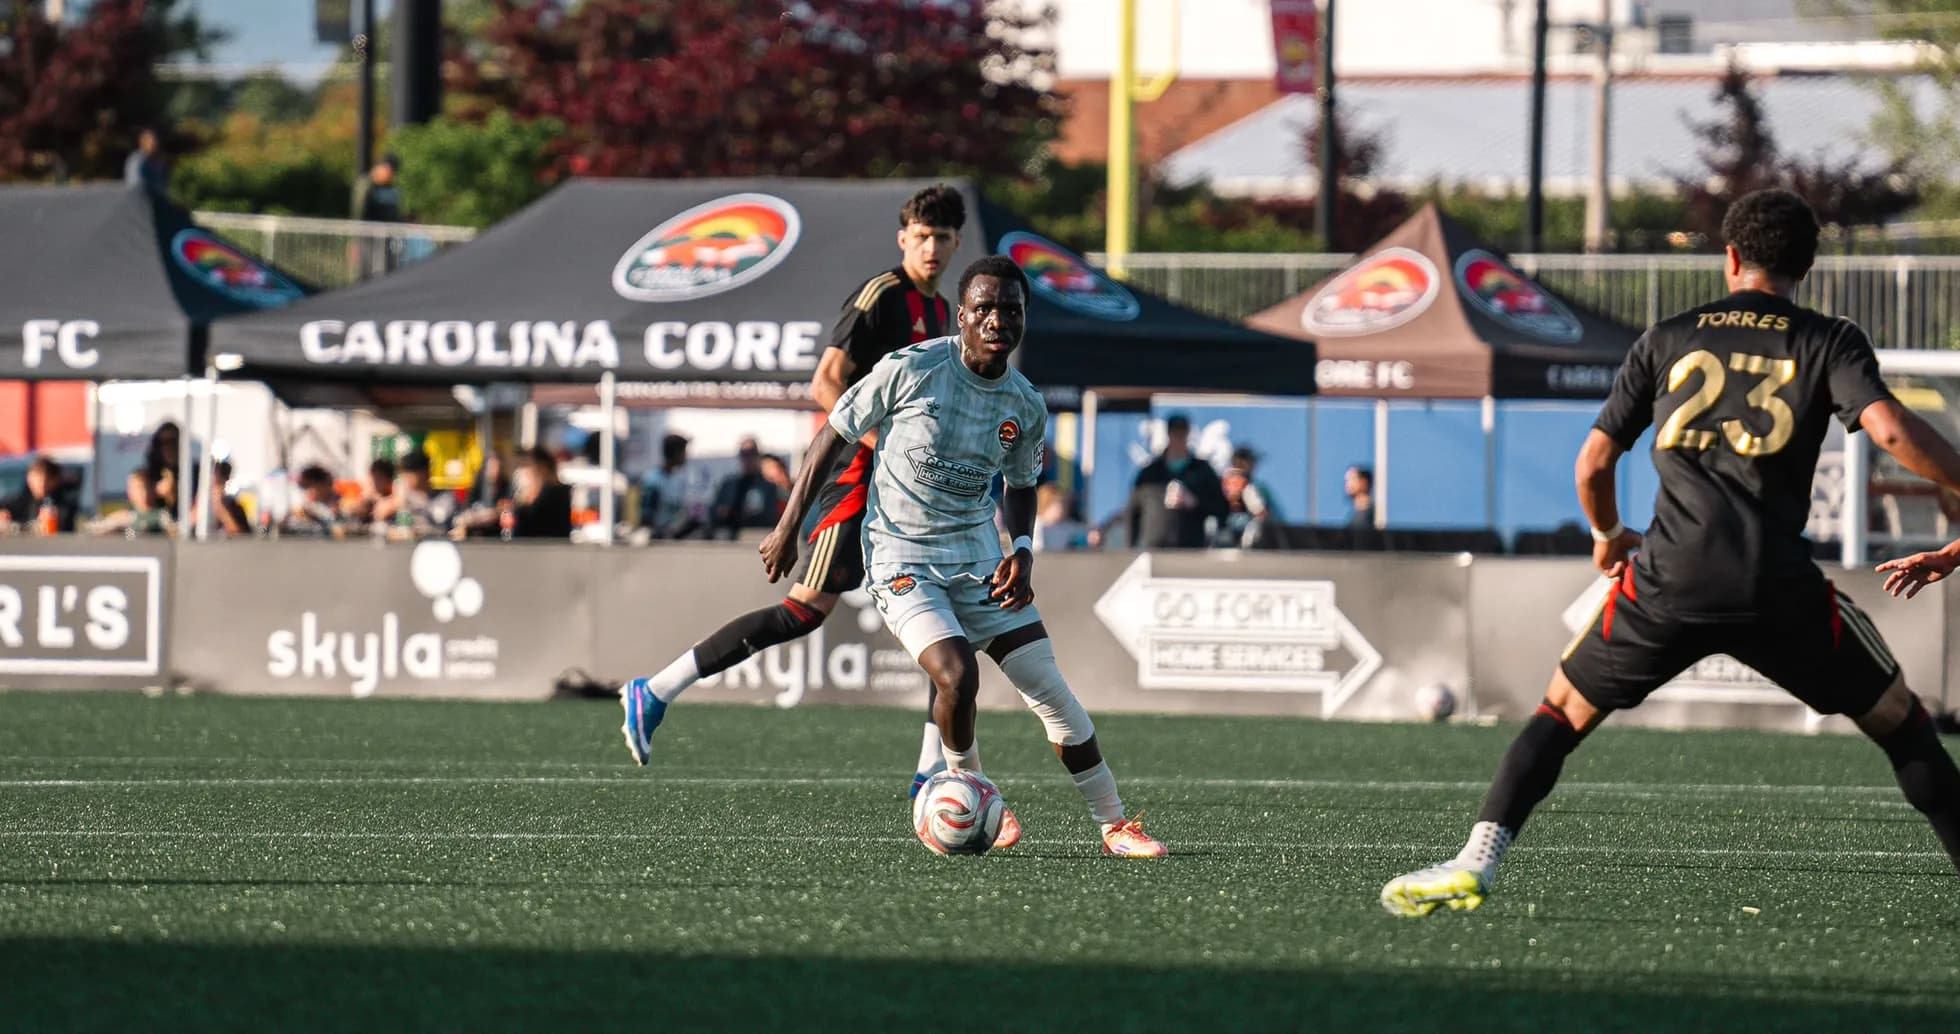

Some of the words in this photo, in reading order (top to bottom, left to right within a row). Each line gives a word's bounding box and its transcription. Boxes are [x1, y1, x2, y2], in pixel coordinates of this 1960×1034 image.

[22, 319, 99, 369] FC
[301, 319, 620, 367] CAROLINA
[643, 320, 823, 370] CORE
[1695, 310, 1791, 332] TORRES
[1656, 349, 1796, 457] 23
[926, 456, 945, 469] GO
[1153, 591, 1198, 622] GO
[1213, 591, 1319, 622] FORTH
[267, 611, 441, 698] skyla
